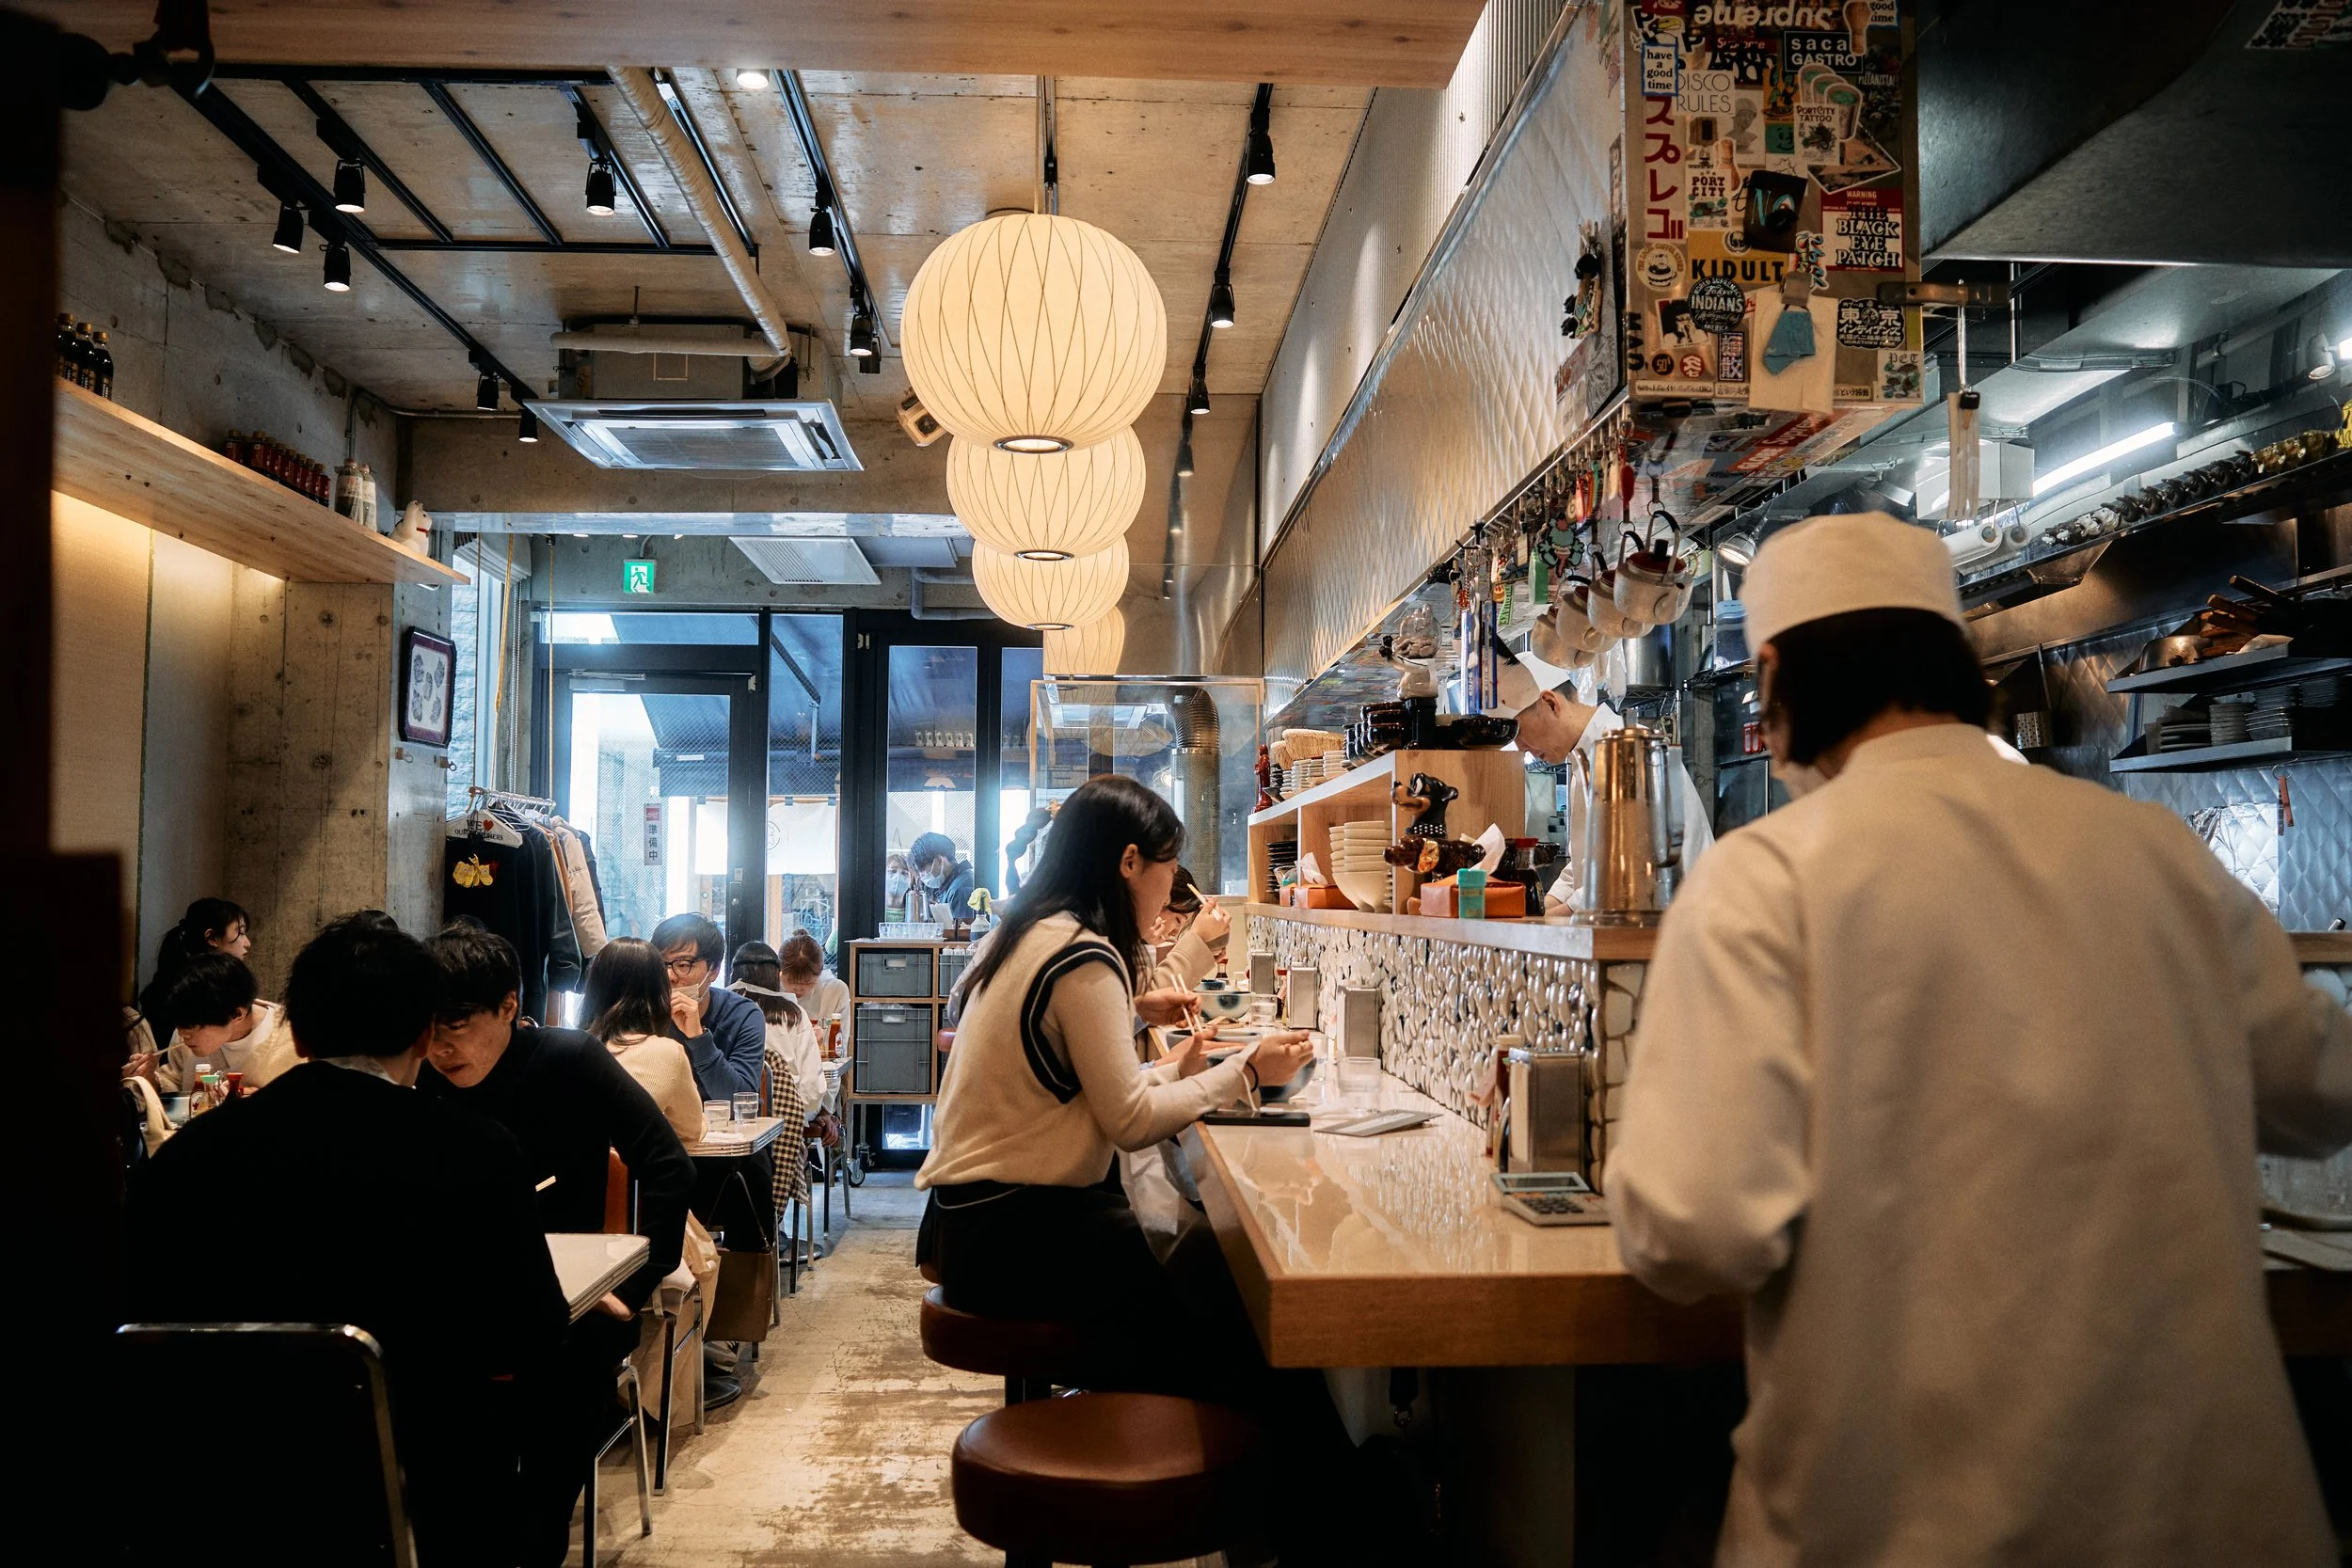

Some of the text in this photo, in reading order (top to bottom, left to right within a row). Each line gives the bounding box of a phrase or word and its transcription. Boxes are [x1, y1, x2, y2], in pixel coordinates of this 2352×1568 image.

[1791, 39, 1847, 51] saca
[1647, 50, 1672, 59] have
[1791, 54, 1857, 67] GASTRO
[1647, 69, 1673, 78] good
[1648, 81, 1672, 89] time
[1677, 73, 1730, 91] DISCO
[1677, 95, 1731, 113] RULES
[1692, 177, 1724, 186] PORT
[1692, 187, 1724, 197] CITY
[1847, 190, 1877, 198] WARNING
[1837, 219, 1899, 238] BLACK
[1851, 235, 1886, 251] EYE
[1836, 249, 1899, 267] PATCH
[1692, 259, 1784, 281] KIDULT
[1691, 294, 1743, 313] INDIANS
[1839, 325, 1901, 335] インディアンズ
[649, 824, 658, 861] 準備中
